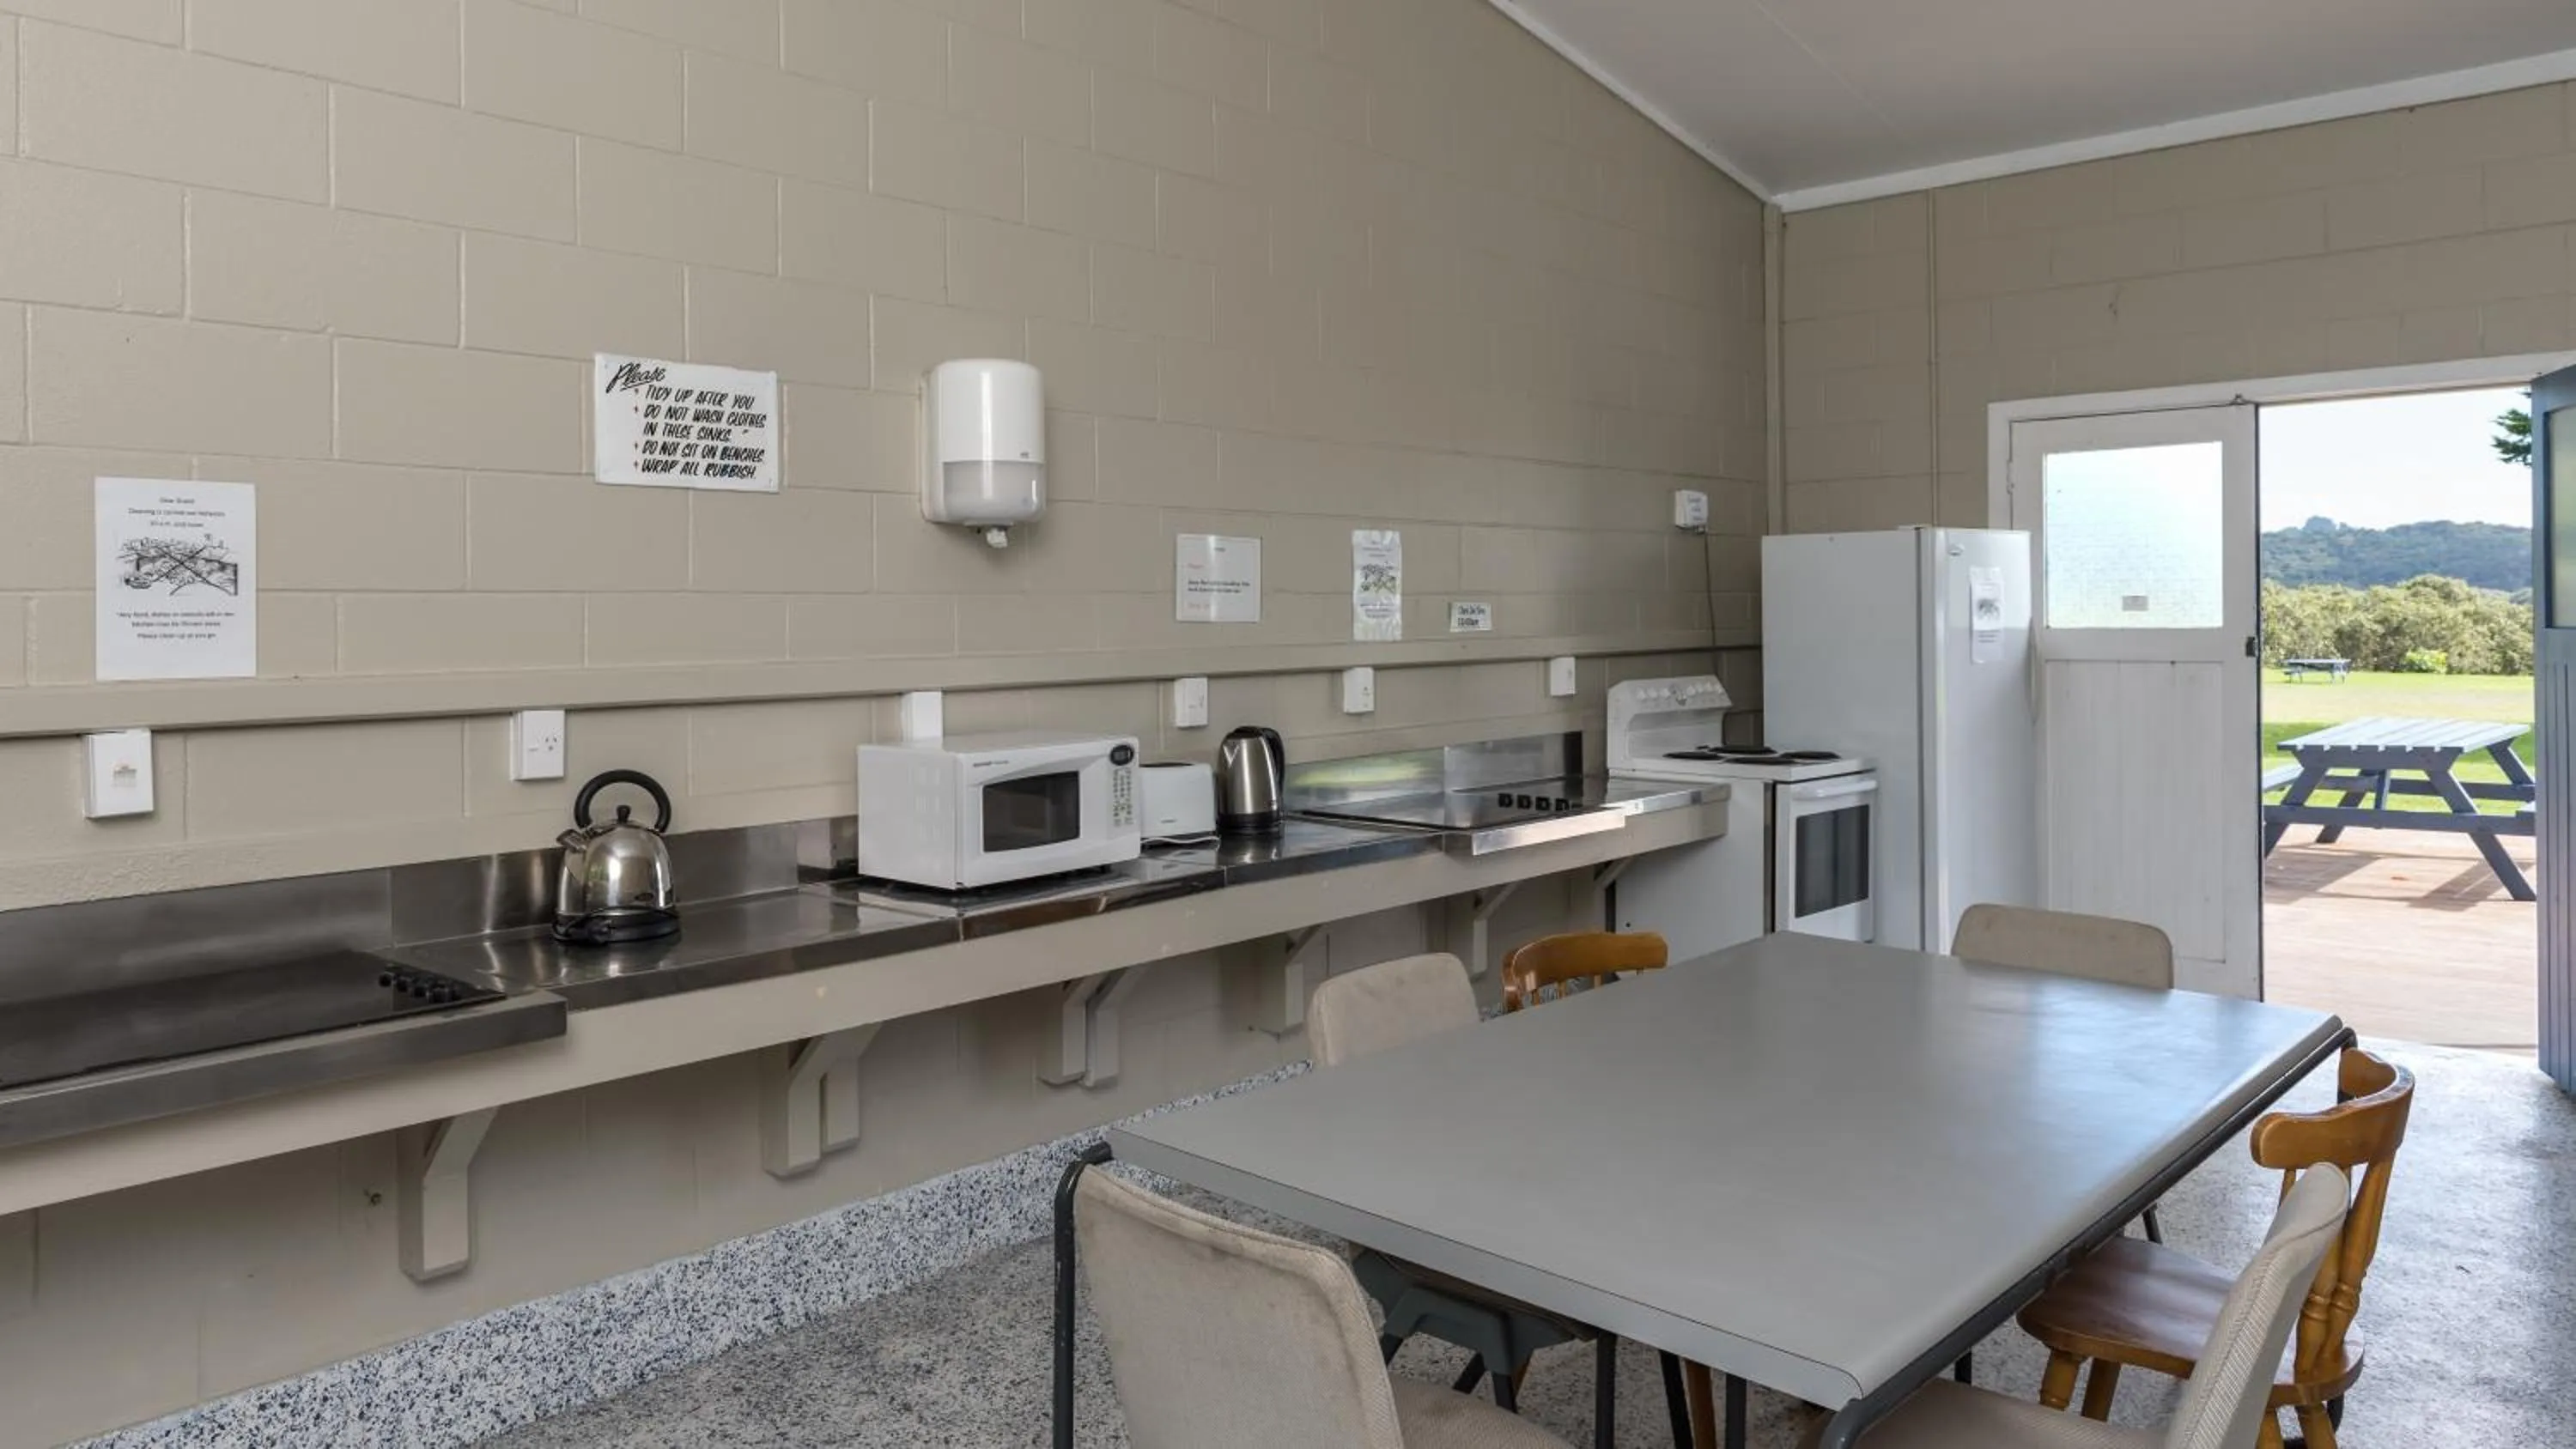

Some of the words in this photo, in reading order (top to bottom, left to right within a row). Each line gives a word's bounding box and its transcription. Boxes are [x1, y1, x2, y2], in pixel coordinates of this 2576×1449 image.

[605, 362, 665, 393] Please
[646, 385, 672, 401] TIDY
[674, 388, 694, 403] UP
[695, 391, 728, 407] AFTER
[732, 394, 755, 409] YOU
[644, 404, 661, 419] DO
[665, 405, 690, 421] NOT
[692, 409, 725, 424] WASH
[726, 411, 767, 427] CLOTHES
[643, 421, 659, 436] IN
[662, 422, 694, 439] THESE
[642, 440, 659, 455] DO
[659, 441, 680, 457] NOT
[682, 443, 699, 458] SIT
[702, 444, 718, 459] ON
[641, 458, 679, 473] WRAP
[680, 461, 700, 476] ALL
